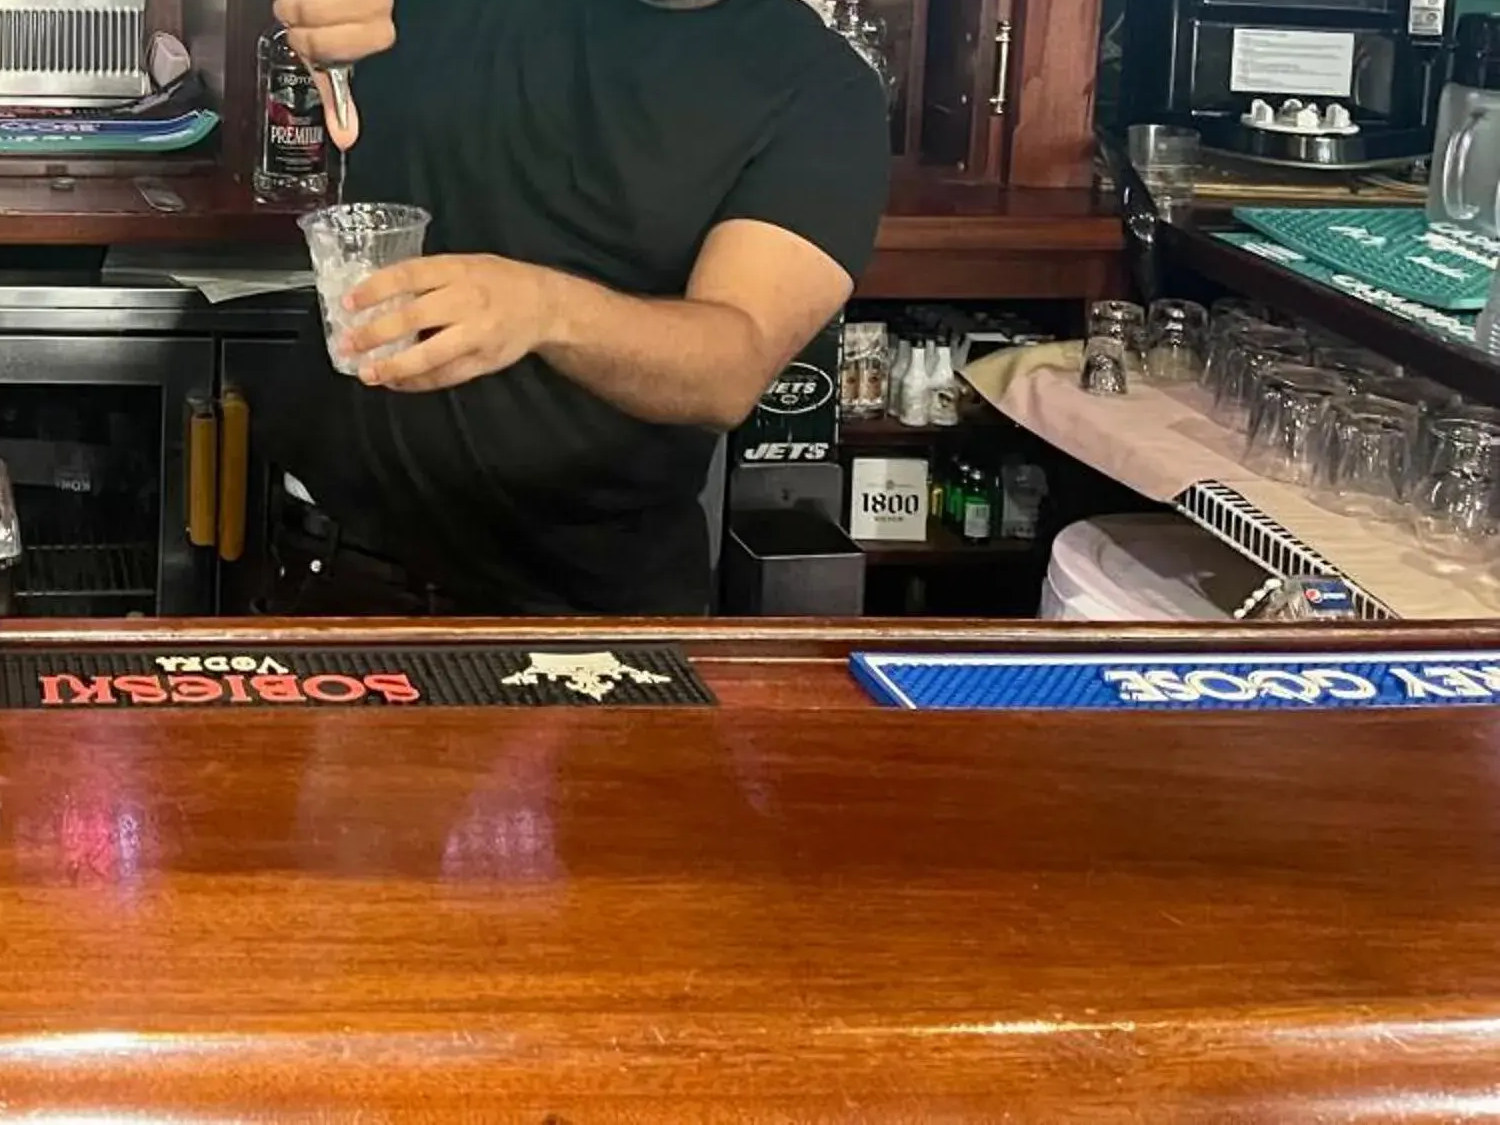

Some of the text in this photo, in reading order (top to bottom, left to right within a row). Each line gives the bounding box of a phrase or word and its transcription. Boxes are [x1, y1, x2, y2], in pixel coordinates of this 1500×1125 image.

[743, 442, 829, 461] JETS
[861, 492, 920, 516] 1800
[38, 673, 420, 705] SOBIESKI
[1104, 669, 1378, 705] GOOSE
